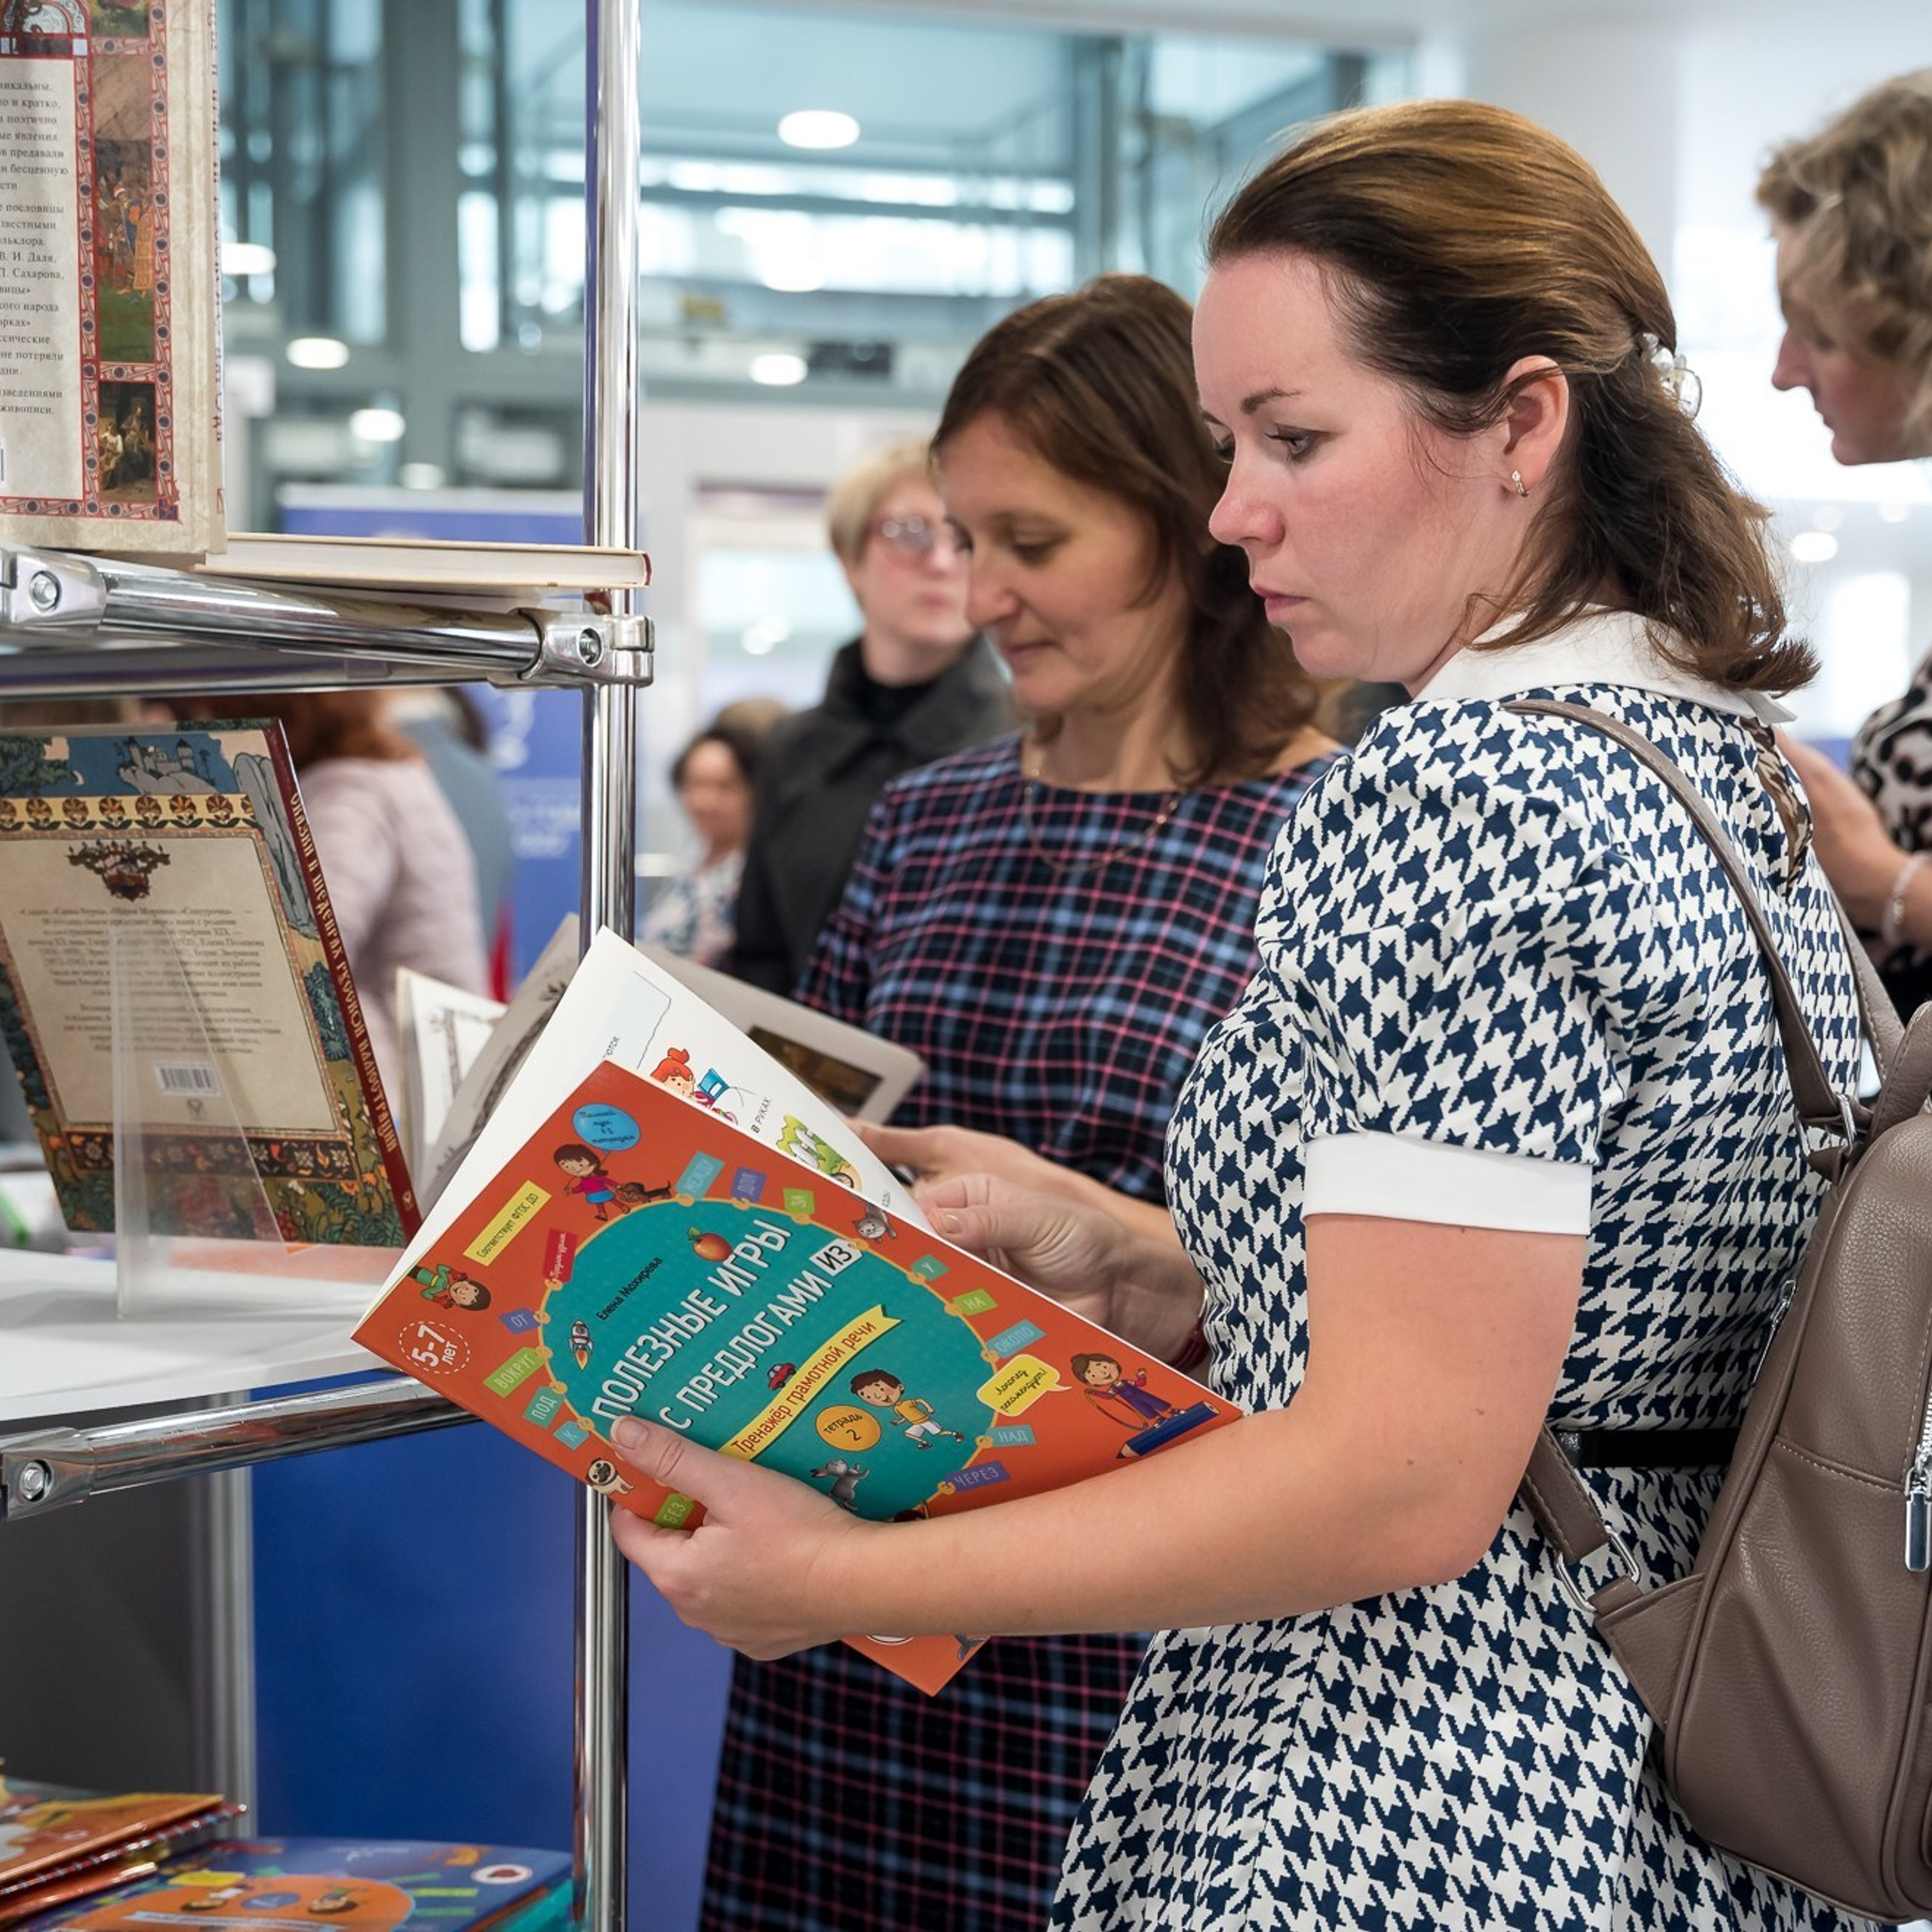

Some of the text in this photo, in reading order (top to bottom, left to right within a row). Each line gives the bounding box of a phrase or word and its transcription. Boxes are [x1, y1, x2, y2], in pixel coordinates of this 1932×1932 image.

[12, 268, 65, 280] Сахарова,
[23, 303, 59, 313] народа
[16, 352, 63, 361] потеряли
[475, 1193, 539, 1257] Соответствует ФГОС ДО
[921, 1262, 934, 1274] У
[595, 1257, 663, 1321] Елена Мохирева
[964, 1297, 986, 1310] НА
[510, 1314, 529, 1327] ОТ
[592, 1219, 792, 1420] ПОЛЕЗНЫЕ ИГРЫ
[411, 1324, 445, 1367] 5-7
[659, 1245, 852, 1430] С ПРЕДЛОГАМИ ИЗ
[994, 1327, 1035, 1353] ОКОЛО
[441, 1340, 458, 1365] лет
[494, 1354, 536, 1389] ВОКРУГ
[731, 1321, 877, 1454] Тренажёр грамотной речи
[531, 1395, 558, 1420] ПОД
[823, 1413, 863, 1434] тетрадь
[563, 1428, 578, 1441] К
[845, 1429, 862, 1441] 2
[998, 1431, 1029, 1443] НАД
[953, 1466, 1000, 1487] ЧЕРЕЗ
[663, 1502, 686, 1524] БЕЗ
